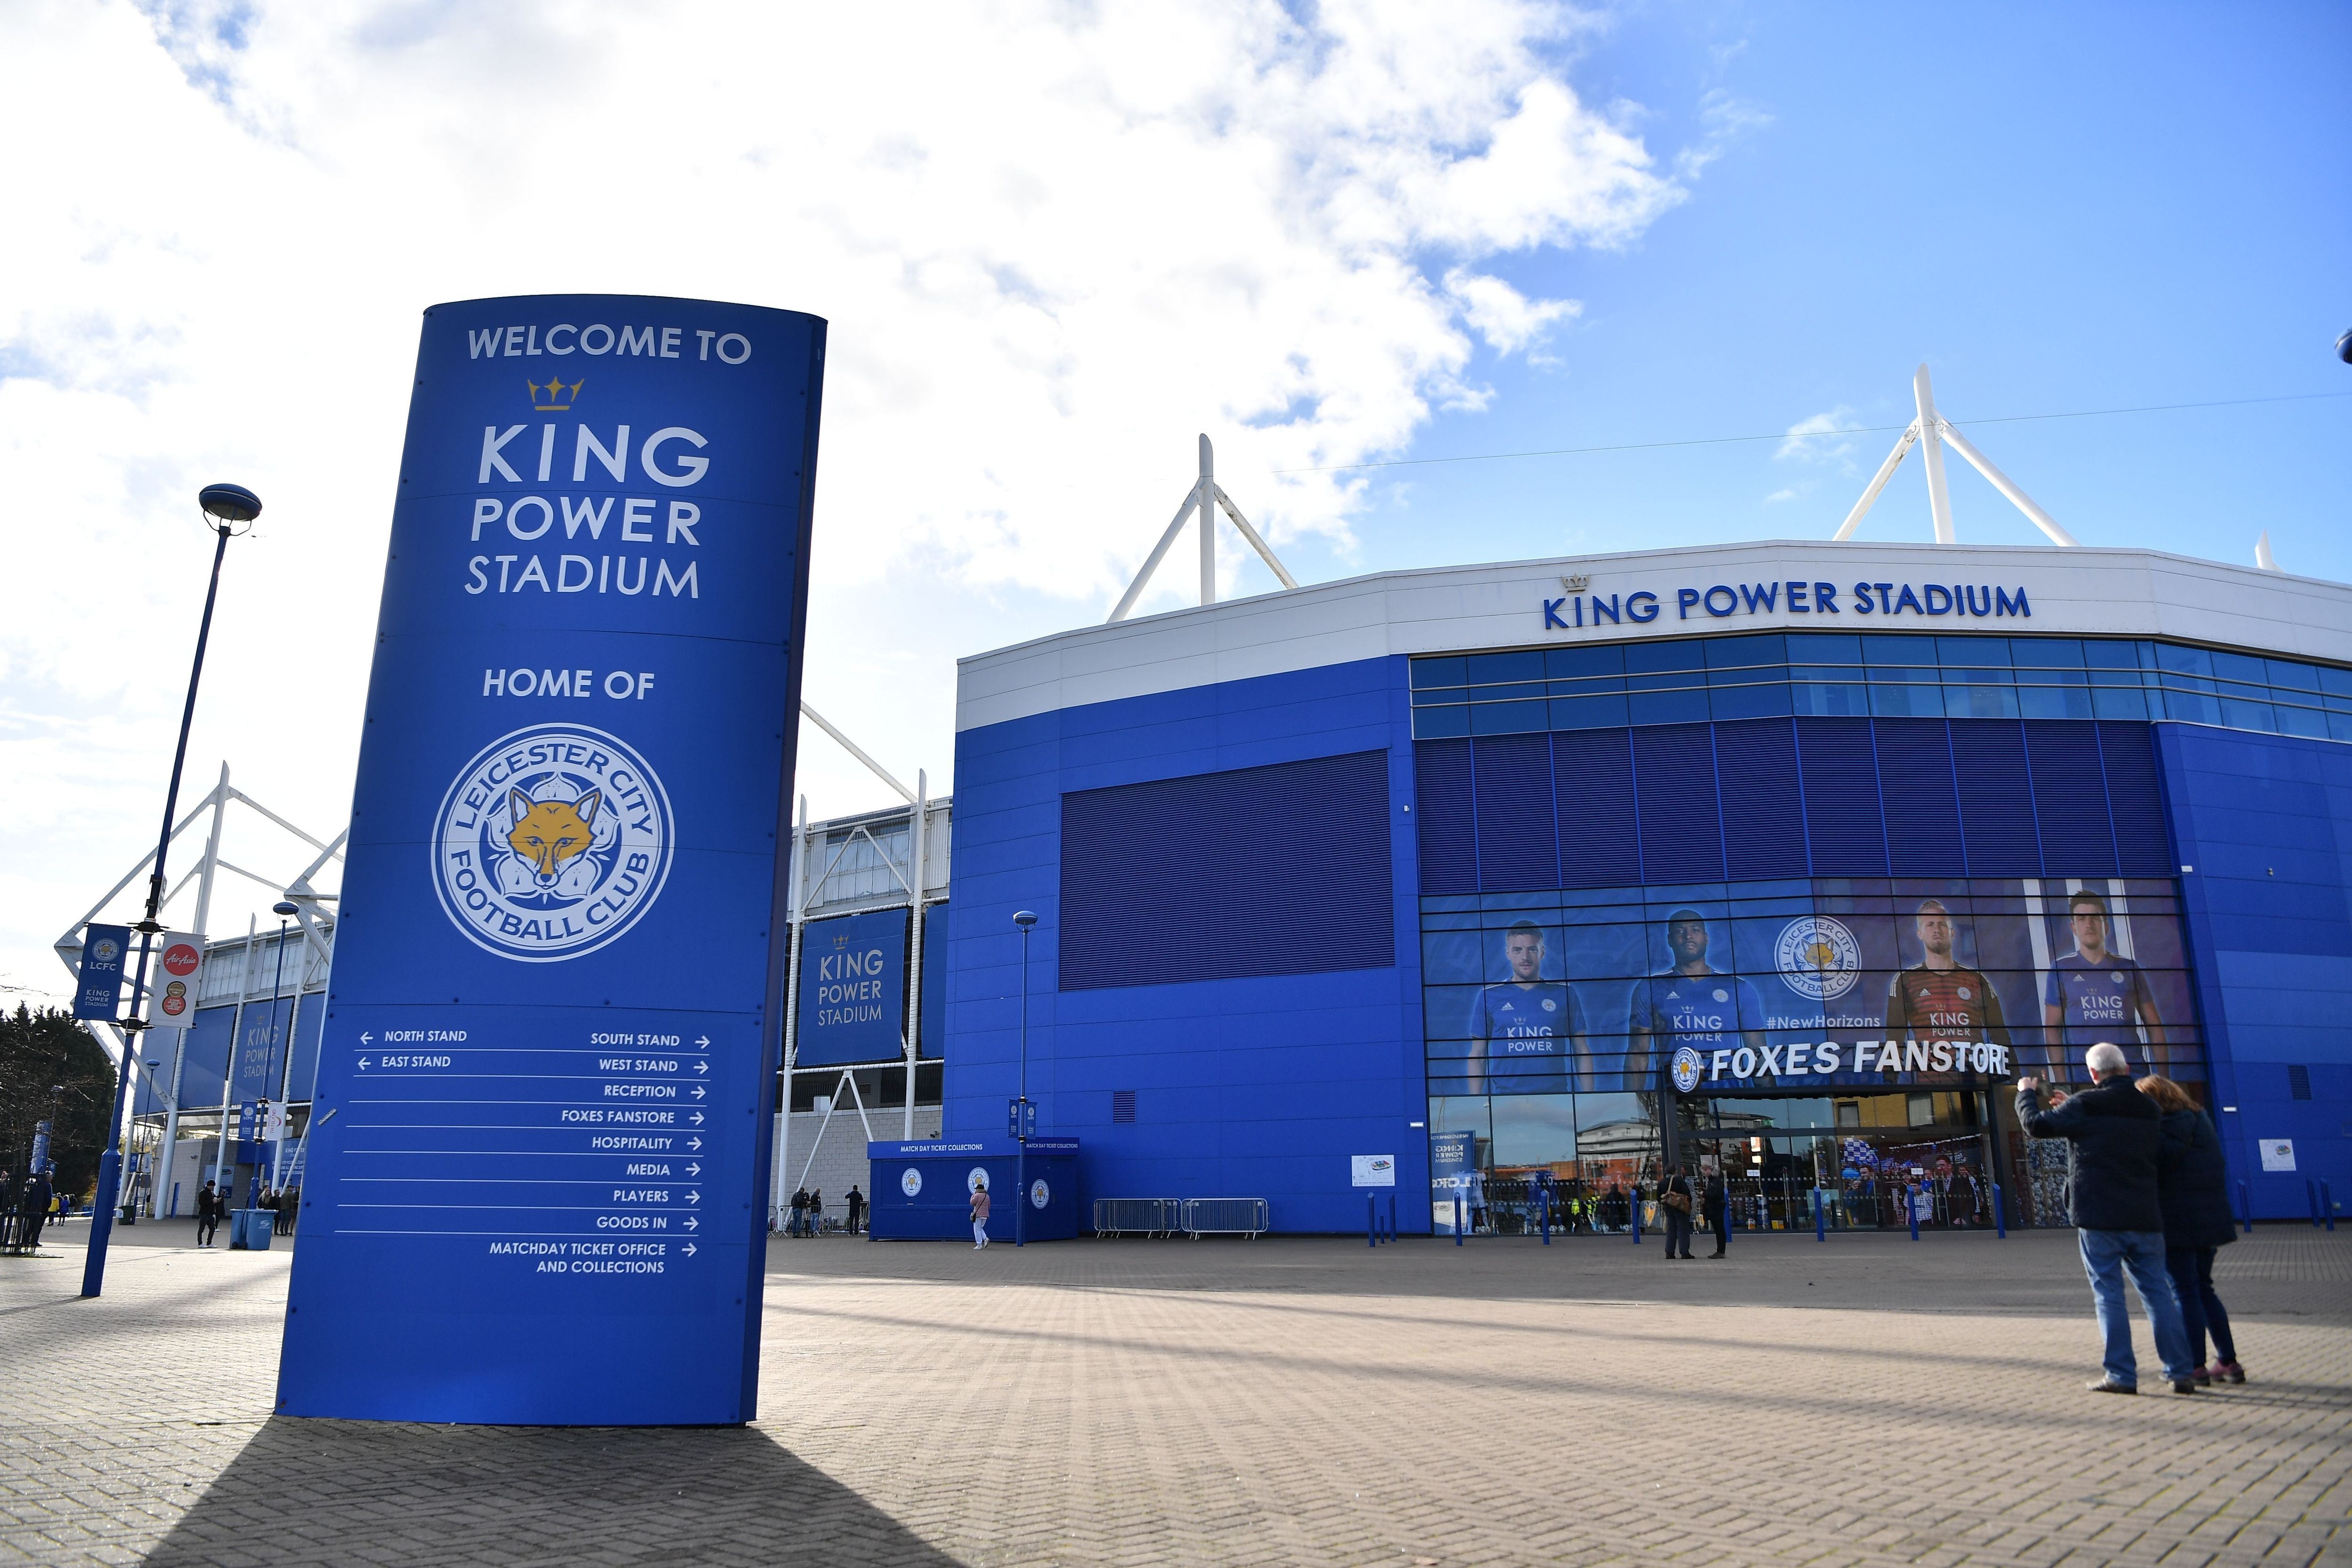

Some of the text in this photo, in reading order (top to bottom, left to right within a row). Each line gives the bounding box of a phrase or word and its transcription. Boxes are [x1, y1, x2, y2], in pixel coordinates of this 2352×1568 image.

[469, 324, 752, 364] WELCOME TO
[478, 423, 709, 487] KING
[471, 496, 700, 546] POWER
[464, 555, 699, 599] STADIUM
[1543, 581, 2032, 629] KING POWER STADIUM
[483, 668, 655, 700] HOME OF
[455, 743, 653, 835] LEICESTER CITY
[451, 849, 650, 941] FOOTBALL CLUB
[1783, 922, 1854, 955] LEICESTER CITY
[166, 953, 196, 966] AirAsia
[820, 949, 883, 981] KING
[89, 962, 117, 971] LCFC
[1783, 960, 1854, 993] FOOTBALL CLUB
[819, 980, 881, 1004] POWER
[2081, 996, 2123, 1009] KING
[818, 1004, 882, 1027] STADIUM
[1766, 1014, 1880, 1029] #NewHorizons
[1929, 1012, 1969, 1026] KING
[2084, 1010, 2124, 1020] POWER
[1673, 1015, 1722, 1029] KING
[384, 1030, 467, 1042] NORTH STAND
[1507, 1026, 1552, 1040] KING
[1675, 1032, 1722, 1042] POWER
[1932, 1028, 1970, 1036] POWER
[591, 1033, 680, 1046] SOUTH STAND
[1508, 1041, 1552, 1052] POWER
[381, 1056, 451, 1067] EAST STAND
[599, 1059, 678, 1072] WEST STAND
[1711, 1040, 2011, 1082] FOXES FANSTORE
[604, 1085, 676, 1098] RECEPTION
[562, 1110, 674, 1123] FOXES FANSTORE
[592, 1137, 673, 1149] HOSPITALITY
[627, 1164, 671, 1176] MEDIA
[613, 1190, 669, 1202] PLAYERS
[596, 1216, 667, 1229] GOODS IN
[489, 1242, 666, 1255] MATCHDAY TICKET OFFICE
[536, 1261, 665, 1274] AND COLLECTIONS
